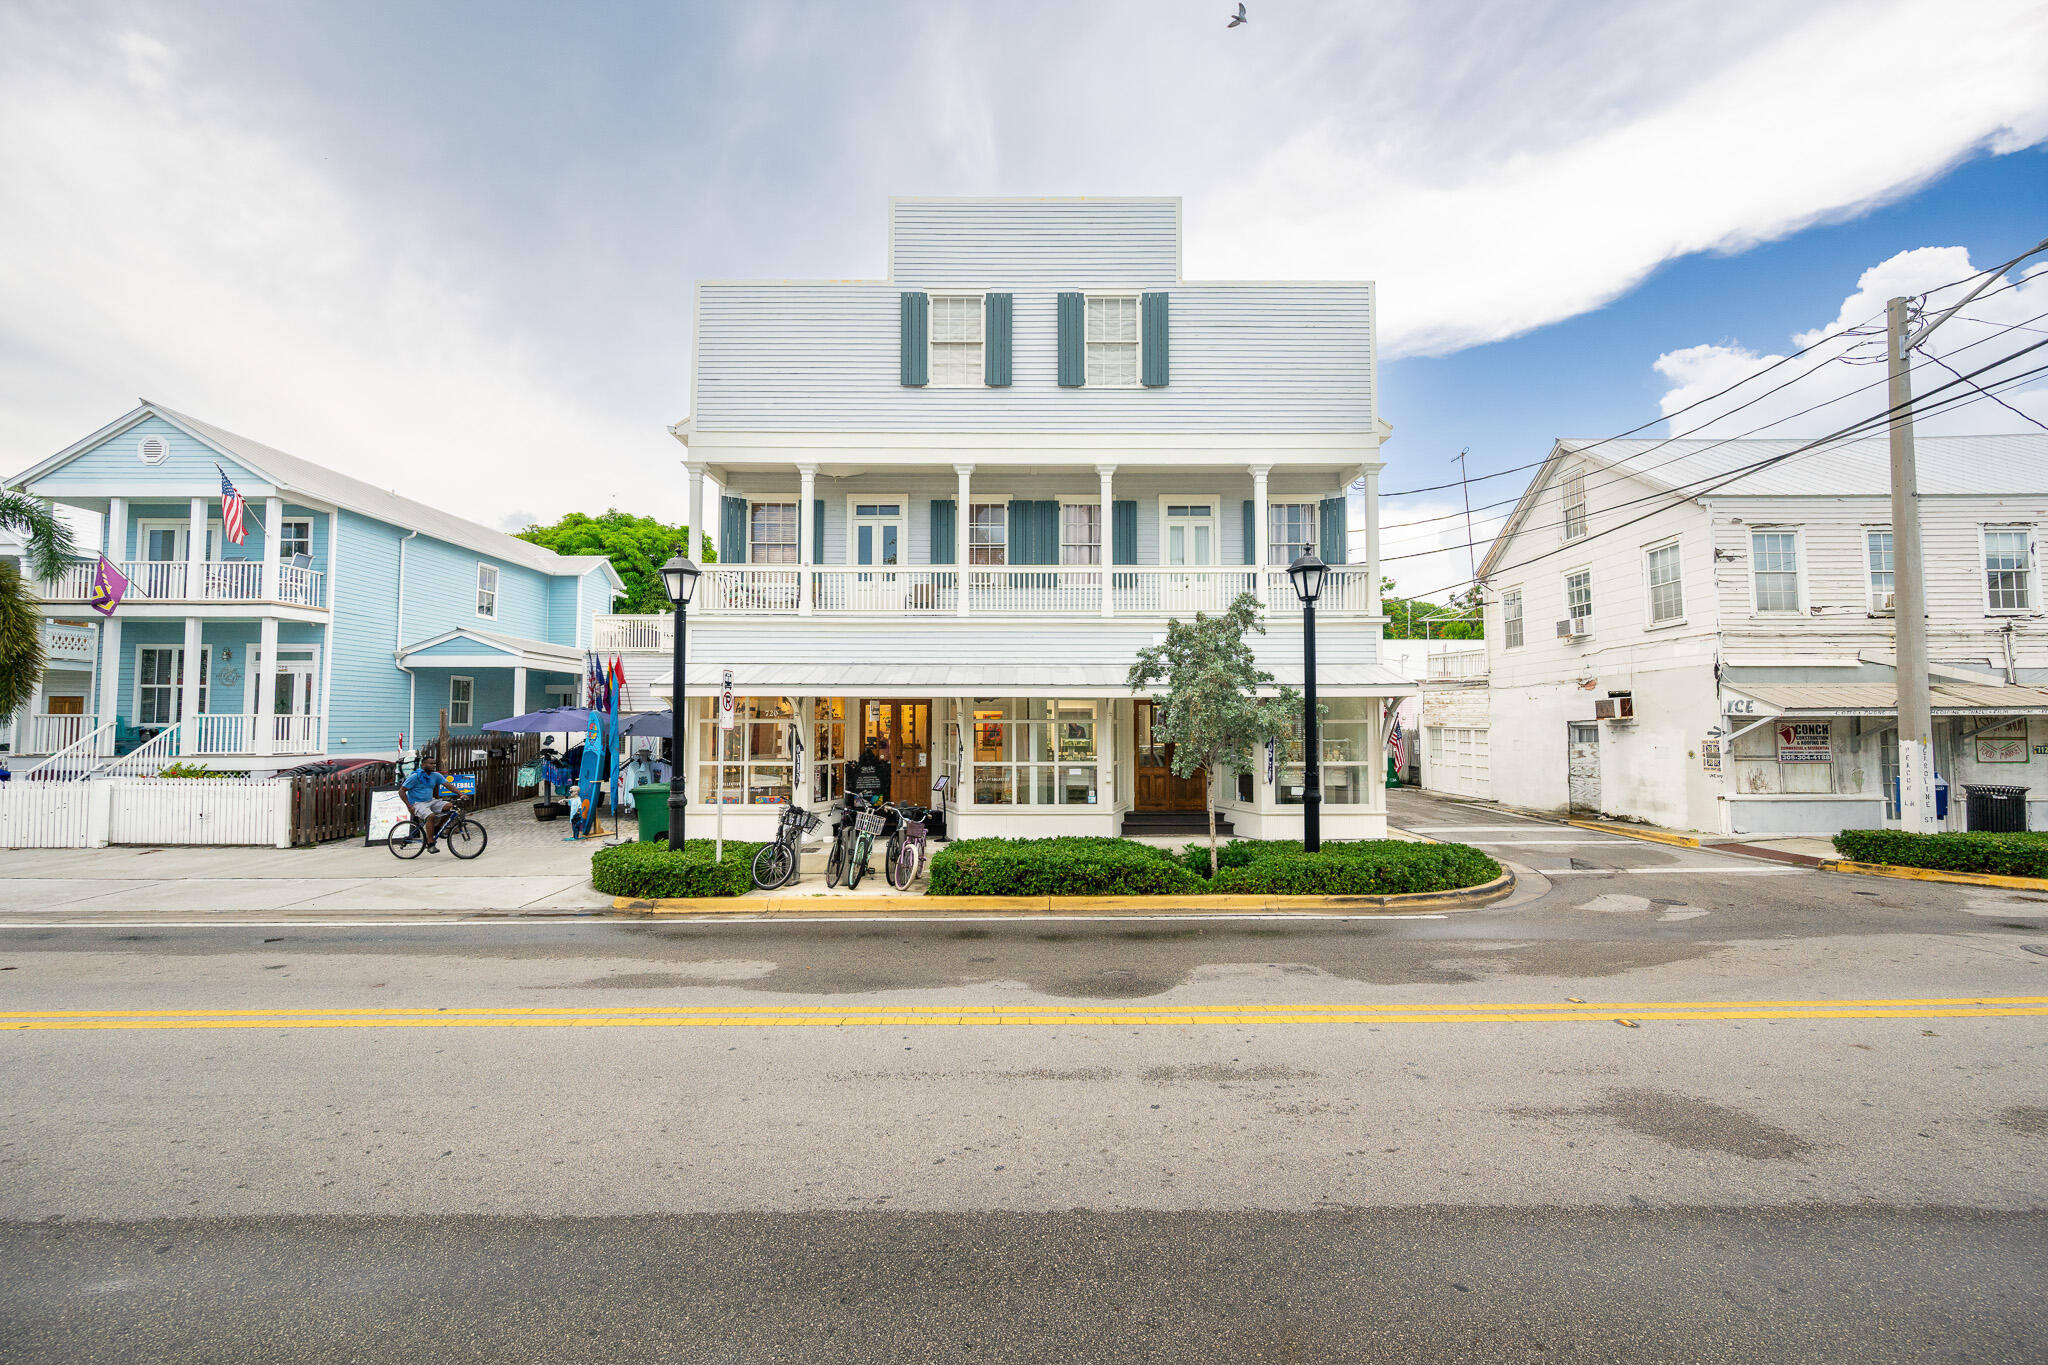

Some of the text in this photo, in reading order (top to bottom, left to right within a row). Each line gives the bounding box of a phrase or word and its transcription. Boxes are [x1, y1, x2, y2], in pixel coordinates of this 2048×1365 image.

[1727, 700, 1754, 713] ICE
[1795, 724, 1829, 735] CONCH
[1979, 745, 1995, 759] FOOD
